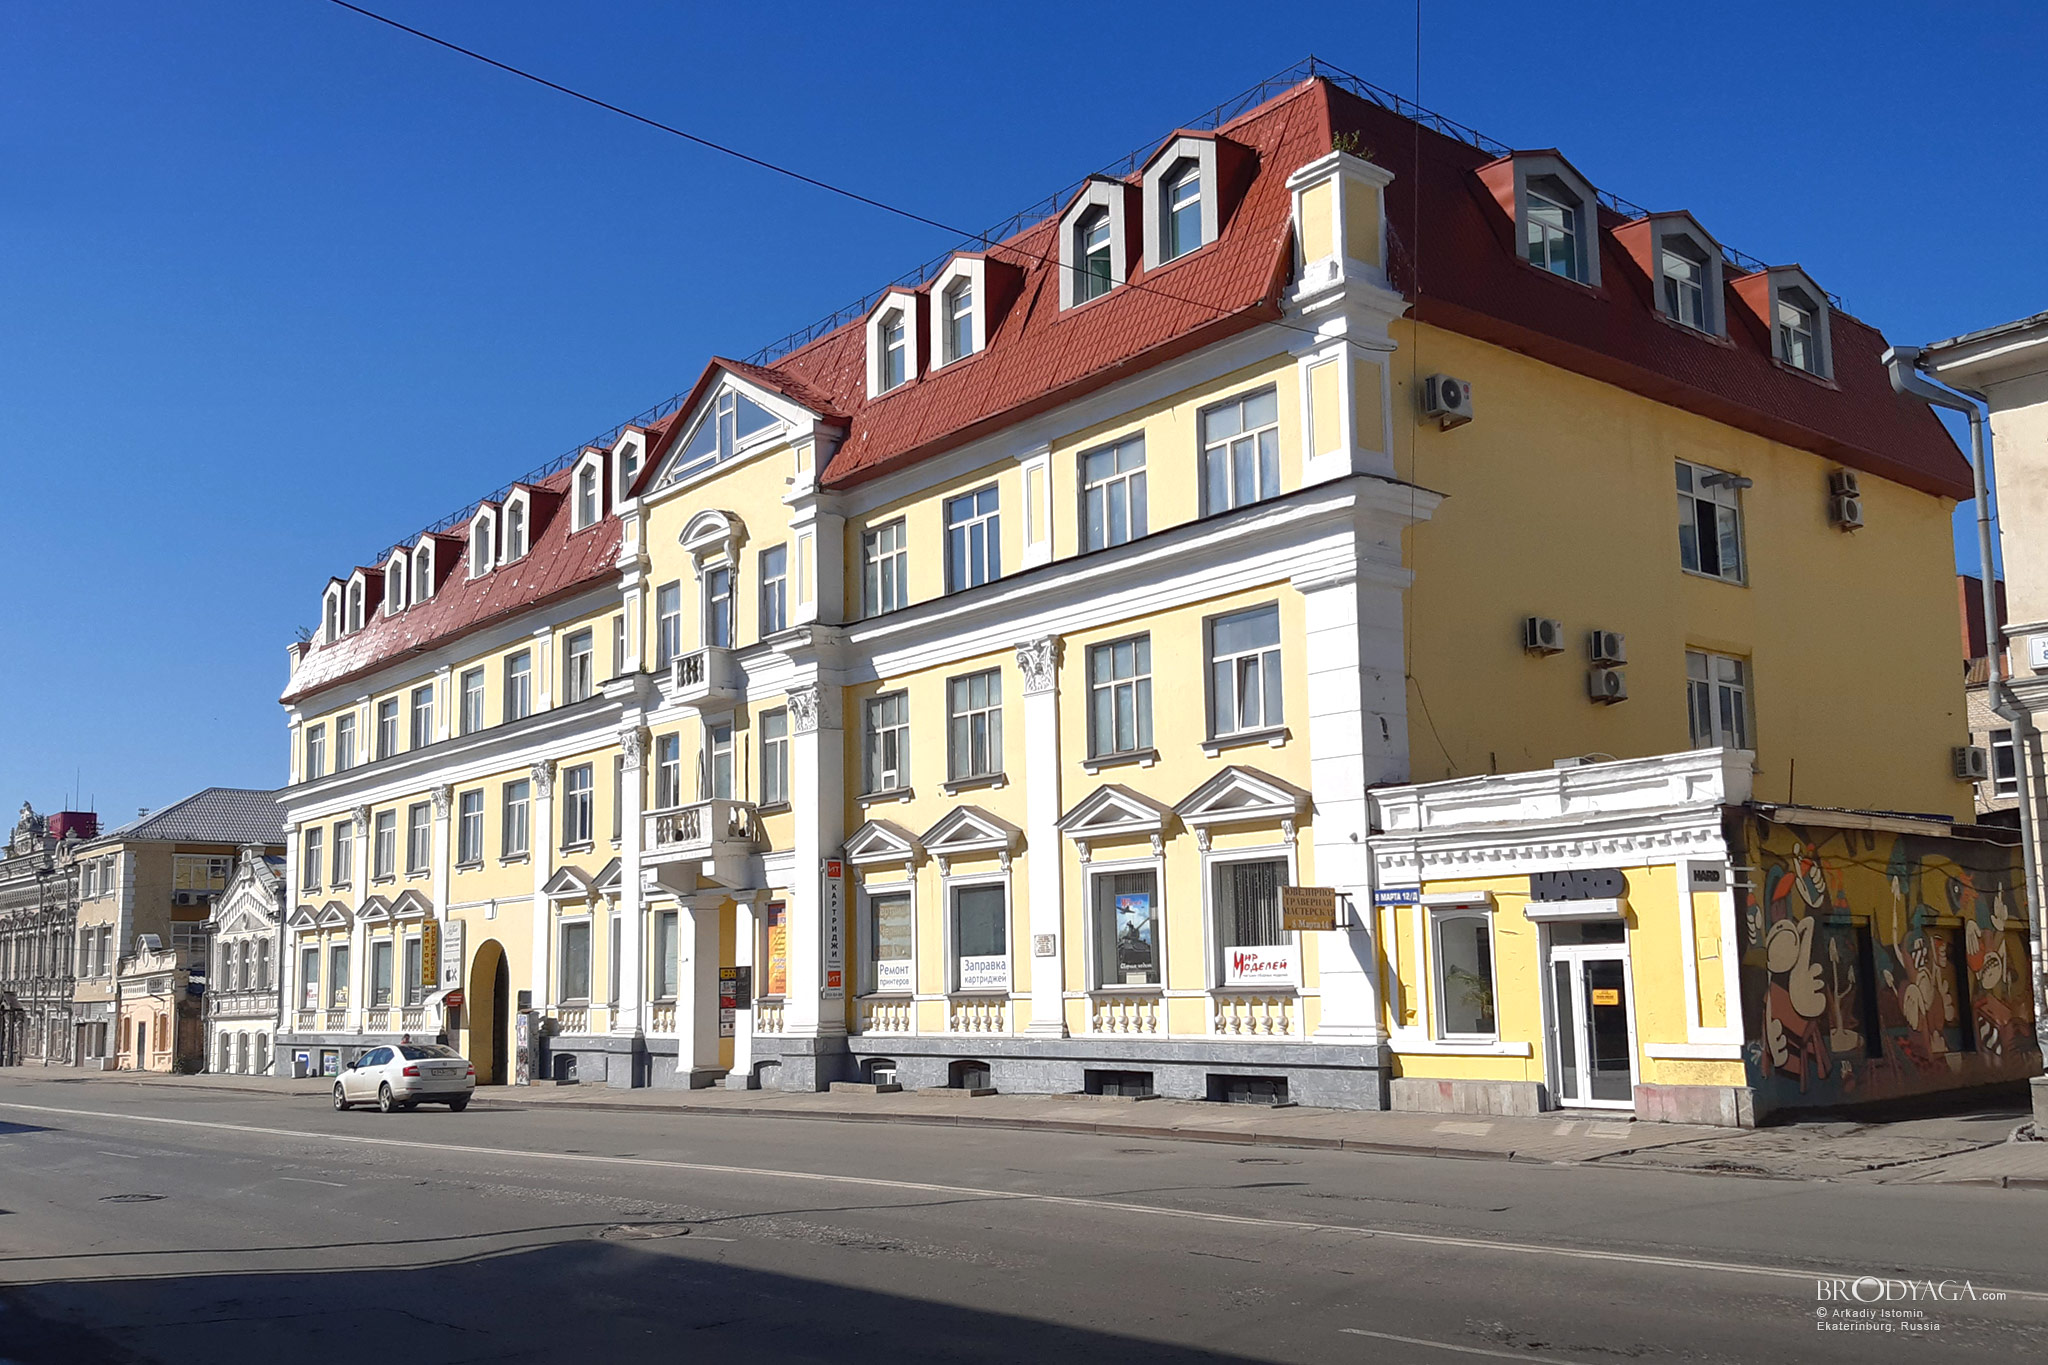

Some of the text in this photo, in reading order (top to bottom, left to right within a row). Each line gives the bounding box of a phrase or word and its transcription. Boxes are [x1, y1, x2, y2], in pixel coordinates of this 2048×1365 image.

[1693, 869, 1720, 882] HARD
[1529, 869, 1625, 900] HARD
[1381, 892, 1401, 901] МАРТА
[1283, 907, 1335, 916] МАСТЕРСКАЯ
[879, 964, 909, 976] Ремонт
[964, 959, 1006, 974] Заправка
[879, 978, 910, 987] принтеров
[964, 972, 1007, 986] картриджей
